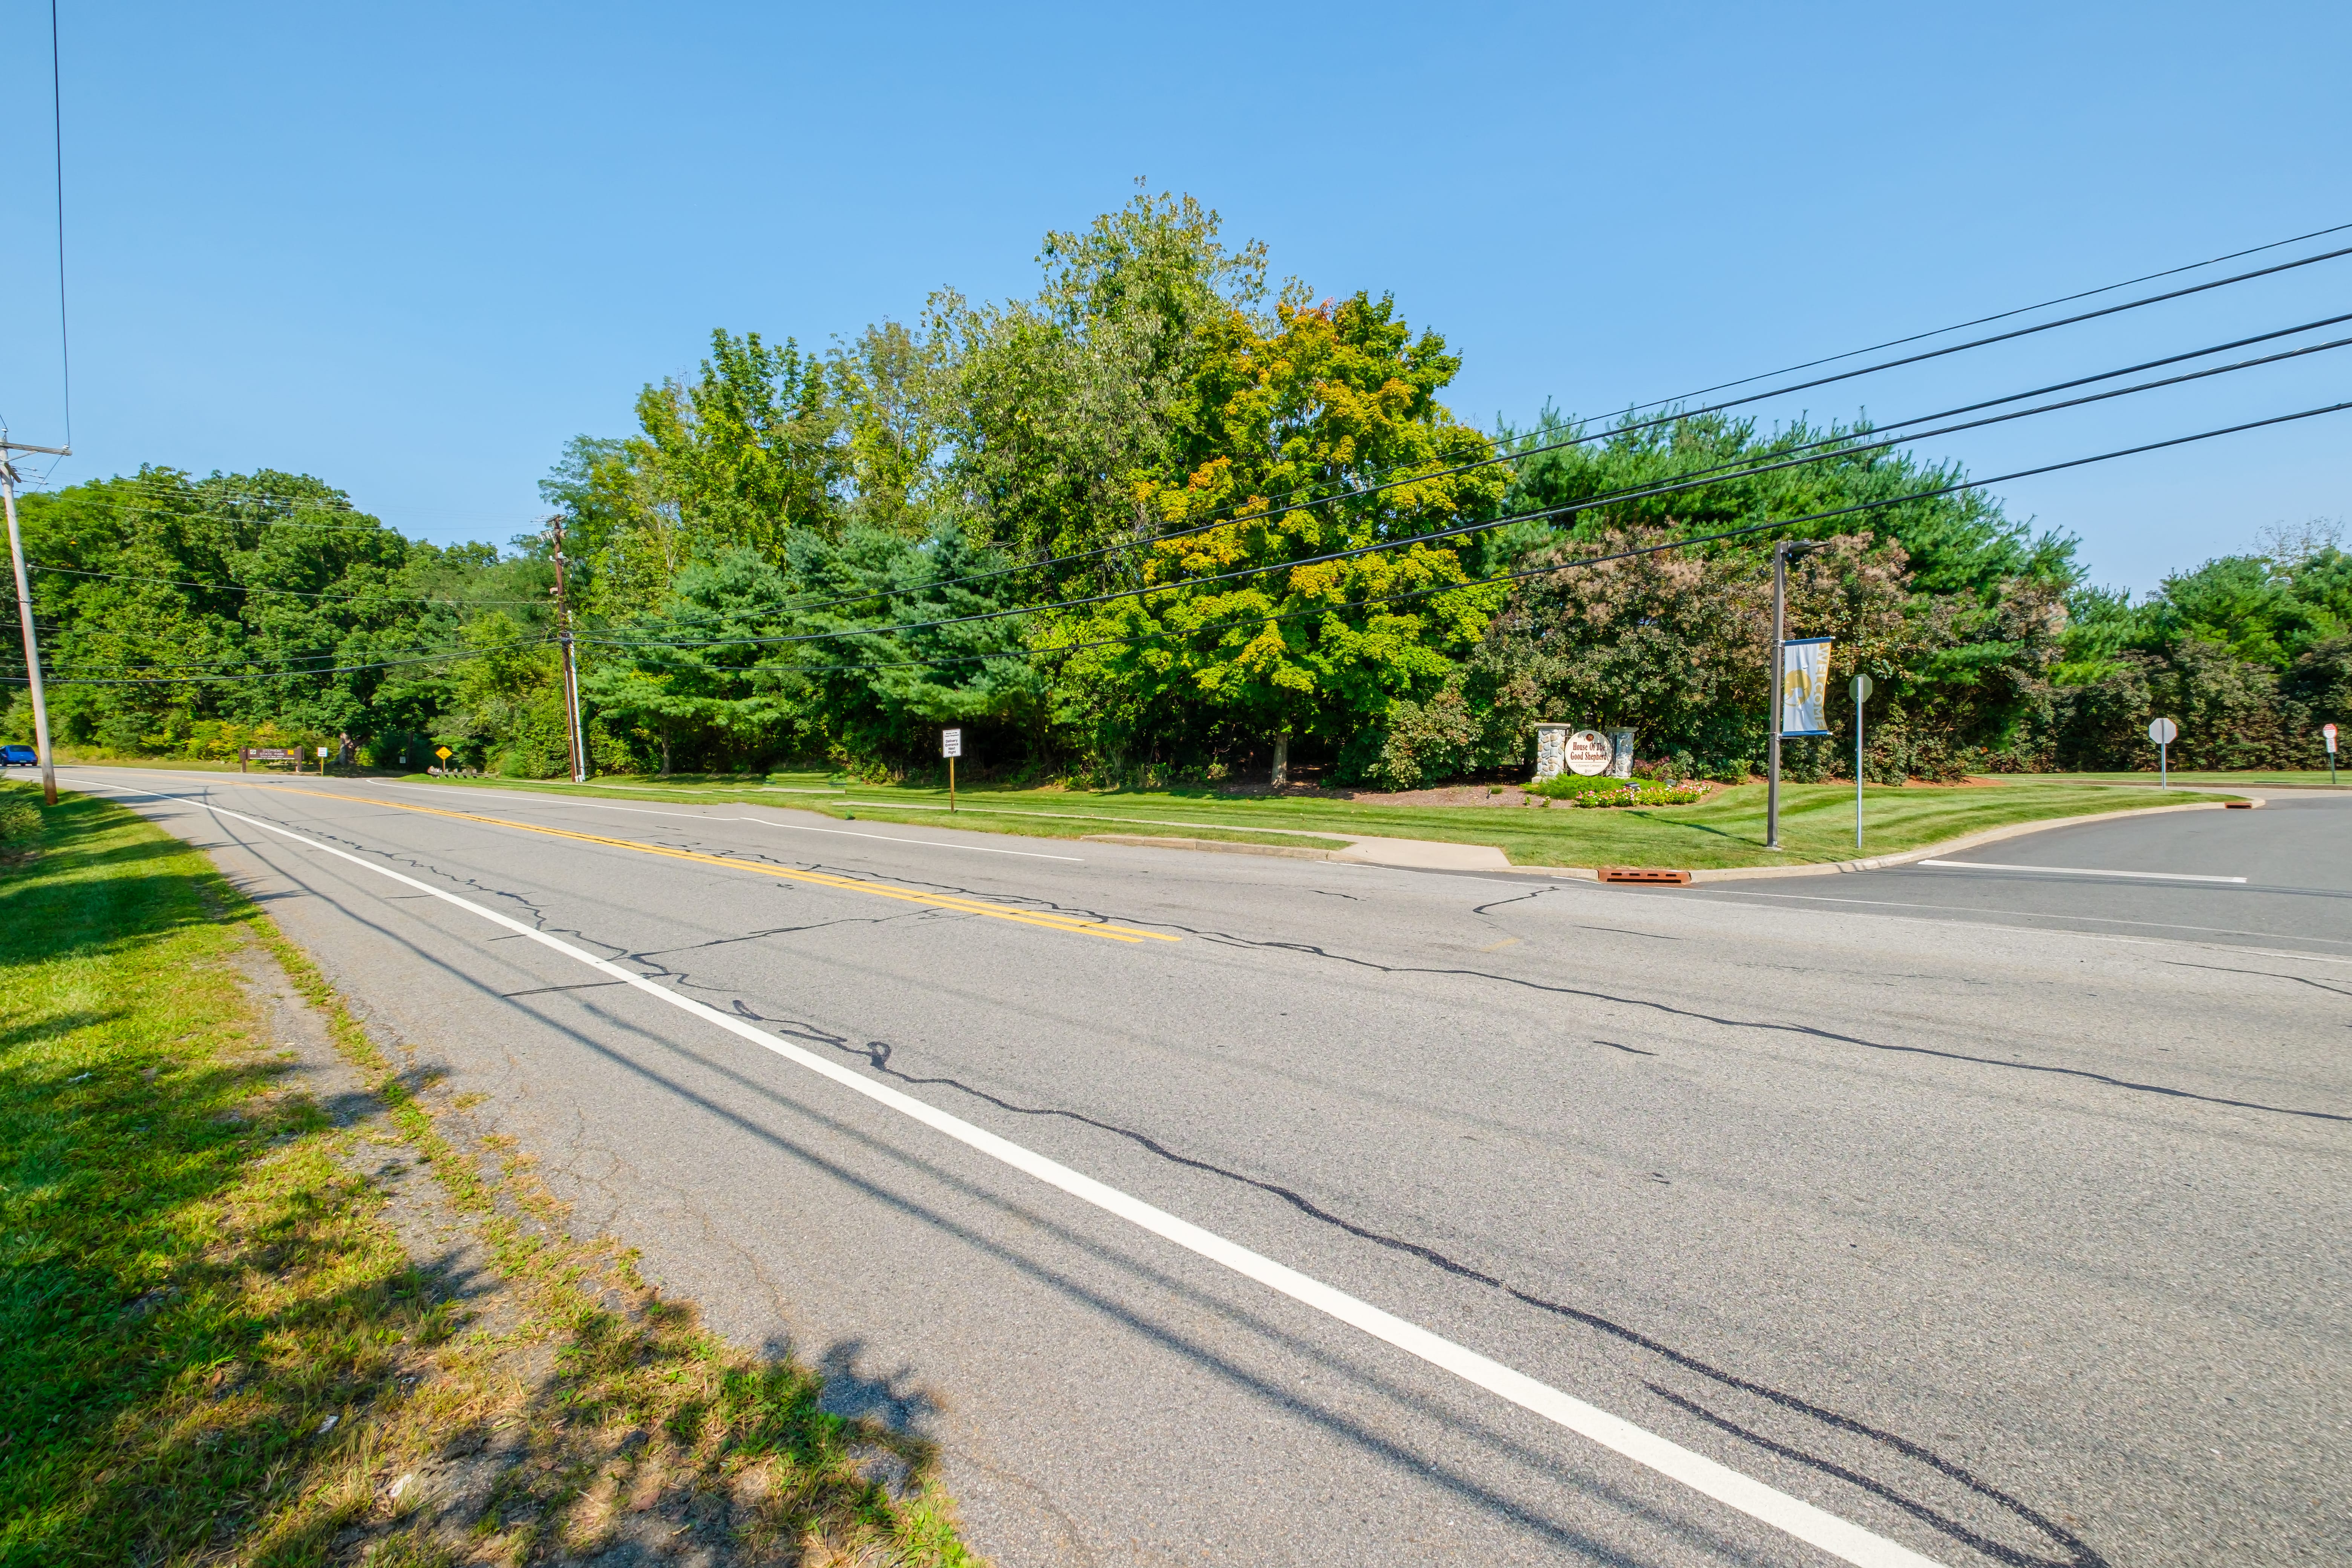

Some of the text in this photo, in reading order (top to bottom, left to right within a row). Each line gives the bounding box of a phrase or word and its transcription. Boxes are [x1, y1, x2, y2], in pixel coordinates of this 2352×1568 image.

[1813, 646, 1829, 729] WELCOME
[1573, 742, 1588, 750] House
[1571, 752, 1606, 761] Good Shepherd
